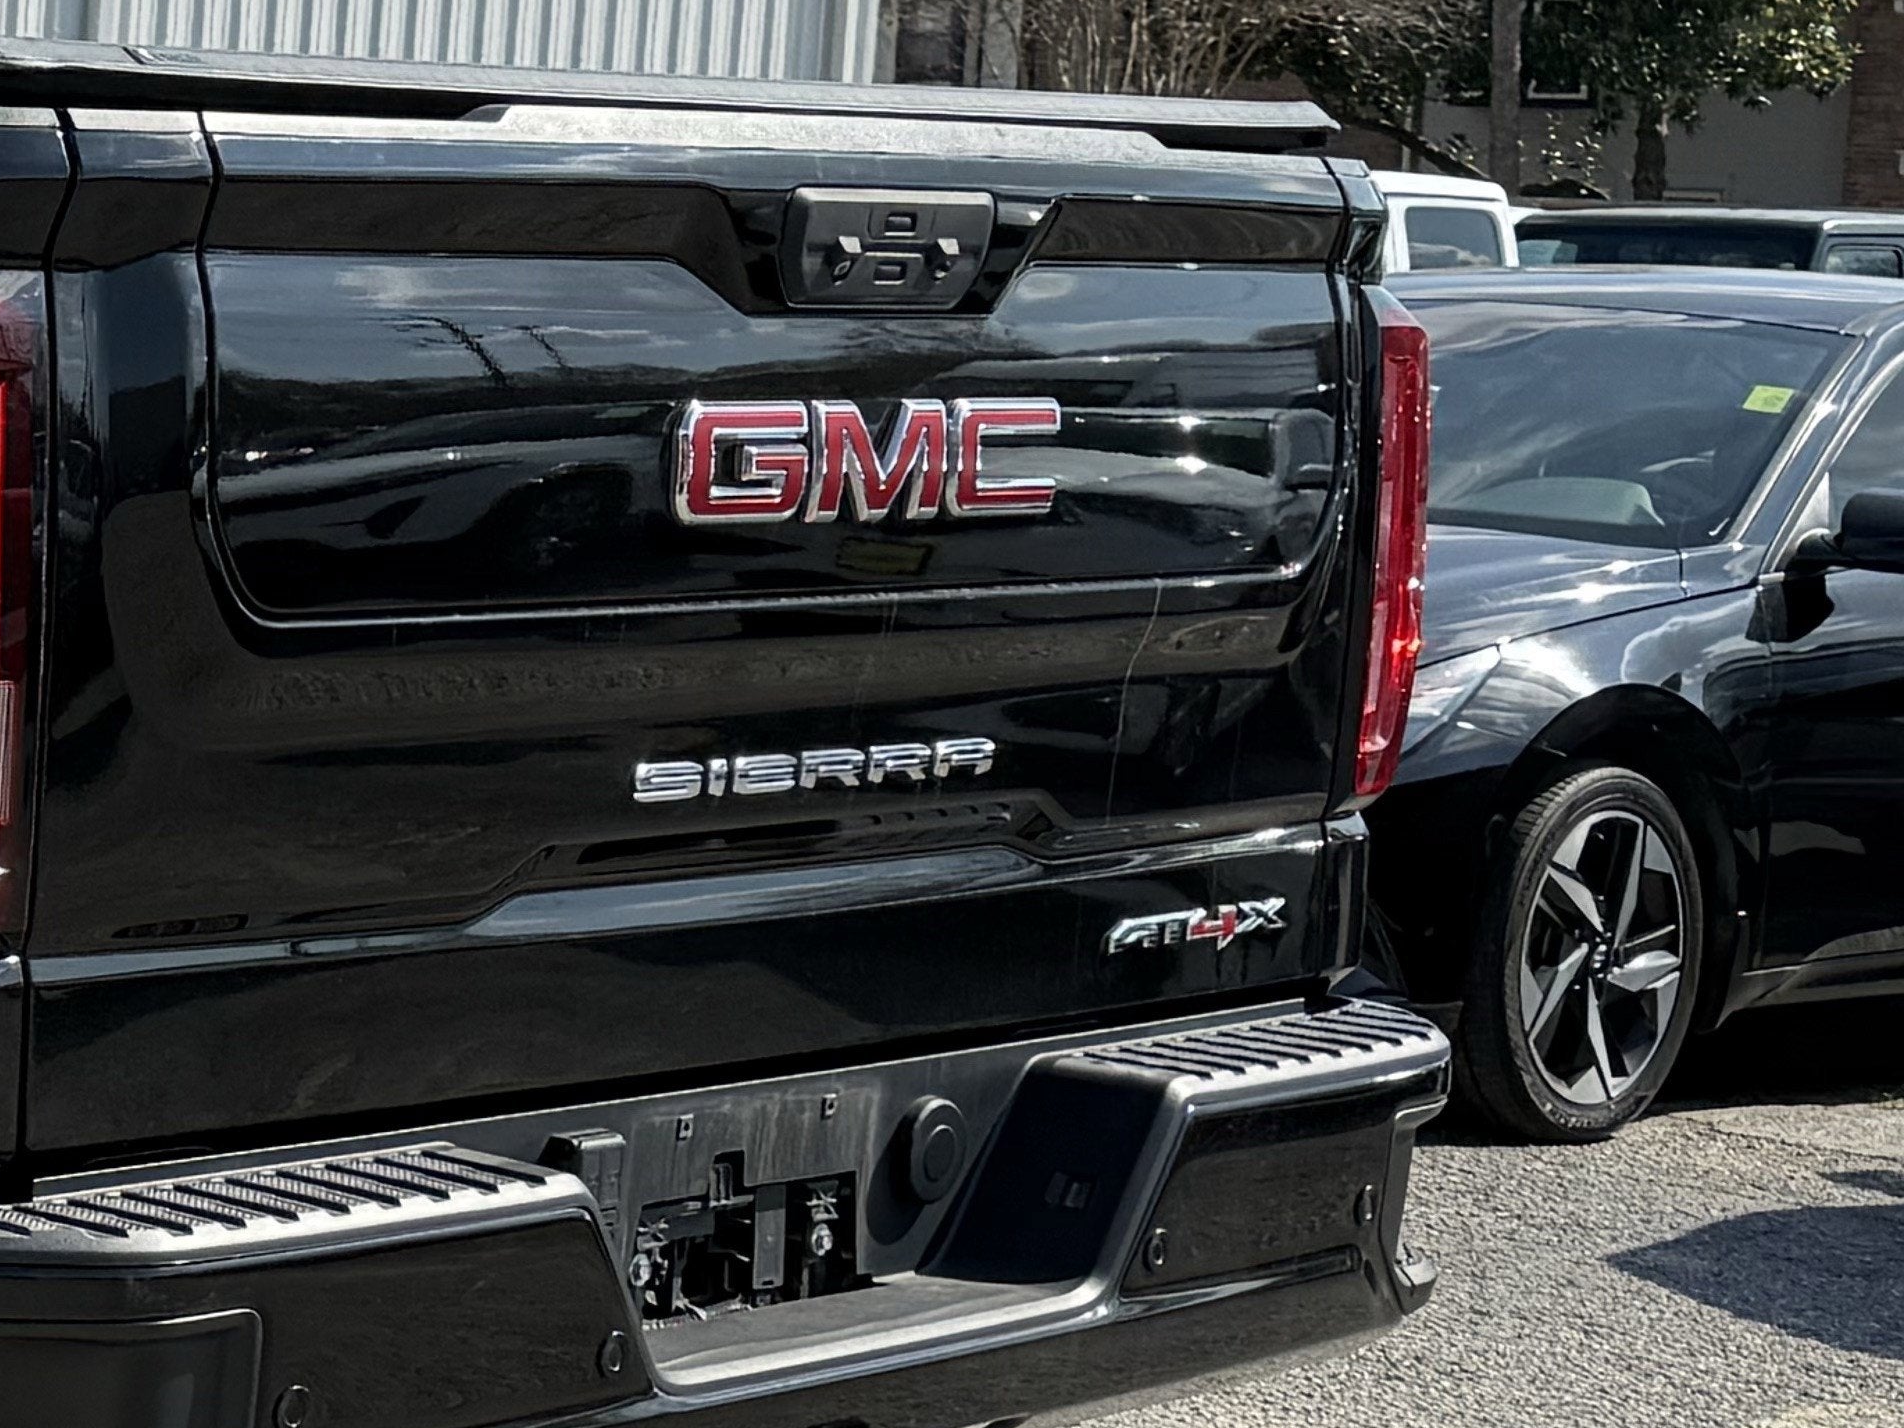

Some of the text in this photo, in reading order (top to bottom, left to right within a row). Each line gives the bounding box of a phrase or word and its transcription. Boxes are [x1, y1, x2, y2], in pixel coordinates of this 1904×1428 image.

[670, 396, 1062, 525] GMC
[632, 736, 996, 804] SIERRA
[1106, 896, 1287, 956] AT4X
